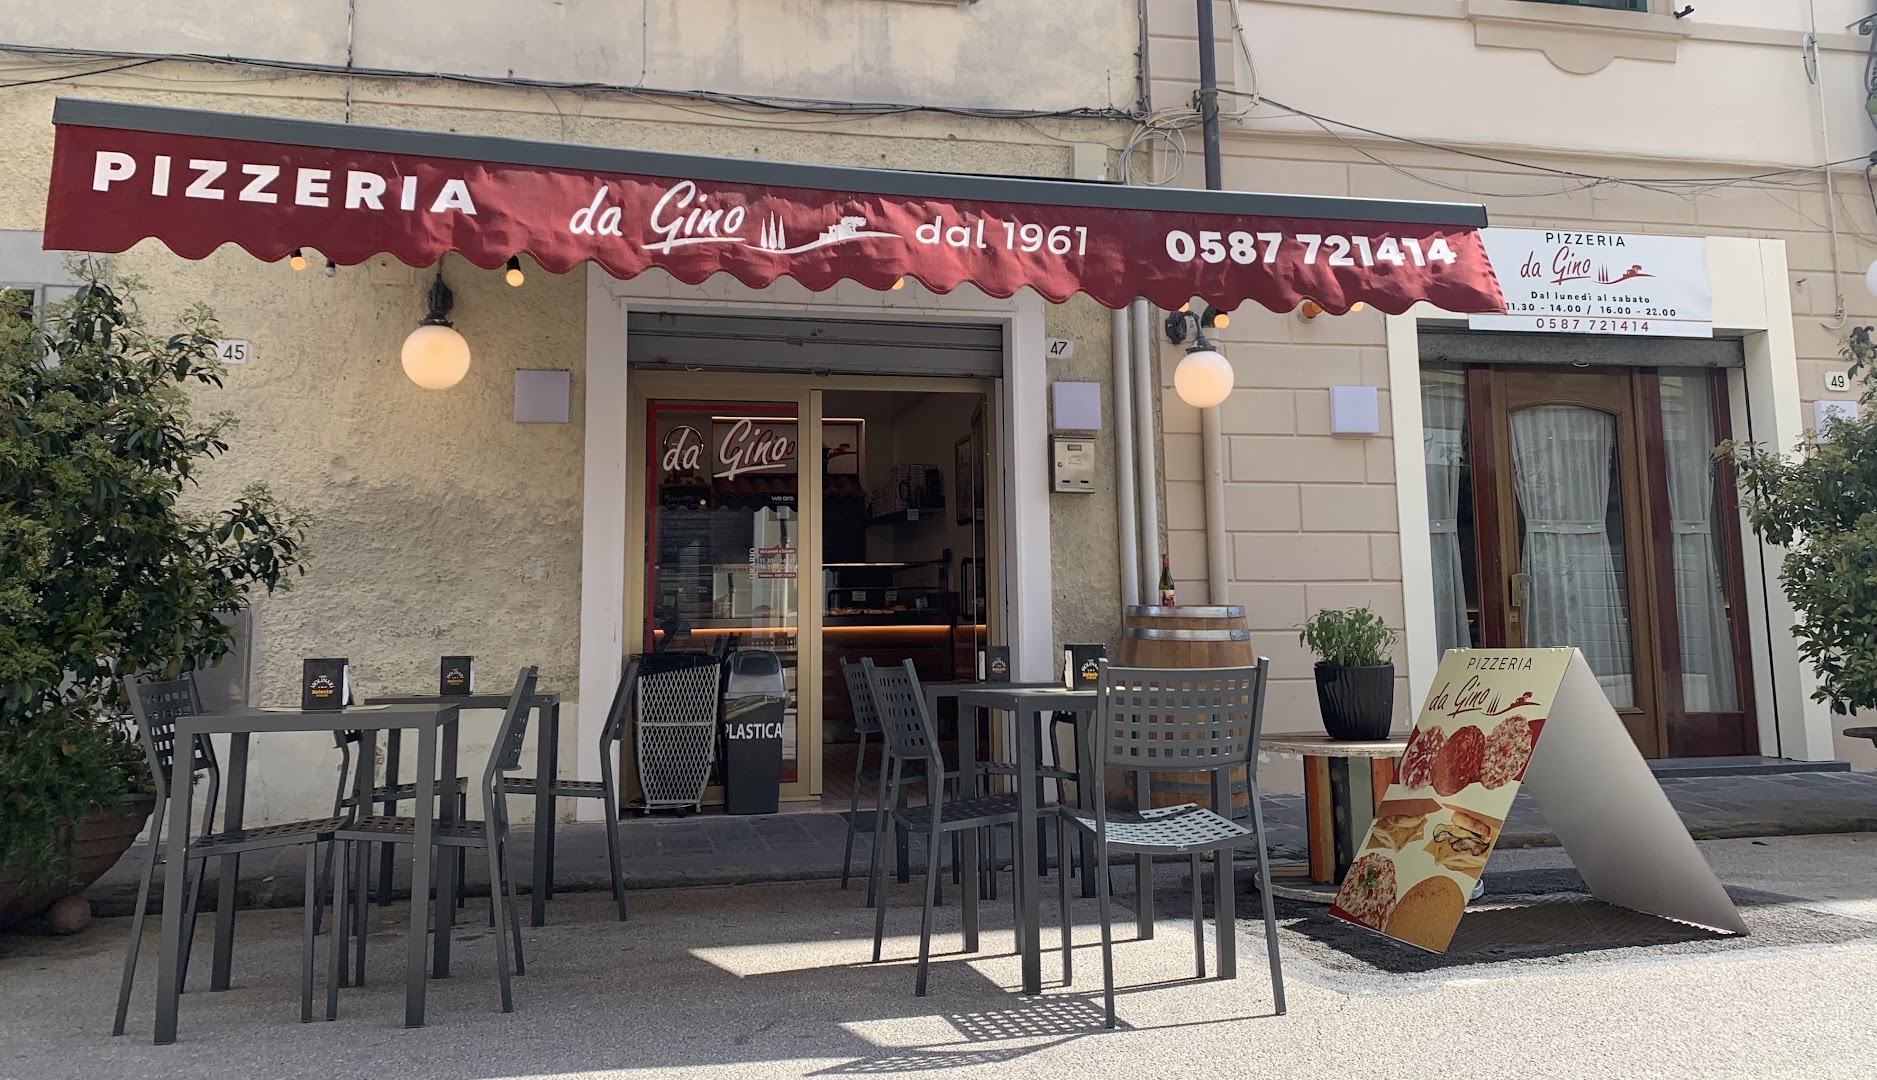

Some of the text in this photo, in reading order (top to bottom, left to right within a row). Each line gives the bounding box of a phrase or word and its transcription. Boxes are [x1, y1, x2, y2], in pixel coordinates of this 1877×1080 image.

[92, 150, 478, 216] PIZZERIA
[569, 180, 1088, 256] da Gino dal 1961
[1545, 232, 1626, 247] PIZZERIA
[1165, 230, 1458, 267] 0587 721414
[1520, 246, 1591, 285] da Gino
[1531, 291, 1650, 303] Dal lunedì al sabato
[1549, 304, 1581, 313] 14.00
[1600, 306, 1631, 315] 16.00
[1646, 307, 1676, 317] 22.00
[1536, 318, 1649, 332] 0587 721414
[223, 344, 245, 360] 45
[1050, 341, 1068, 355] 47
[1831, 375, 1845, 388] 49
[662, 419, 787, 481] da Gino
[1466, 657, 1533, 671] PIZZERIA
[1428, 675, 1490, 718] da Gino
[724, 722, 783, 740] PLASTICA
